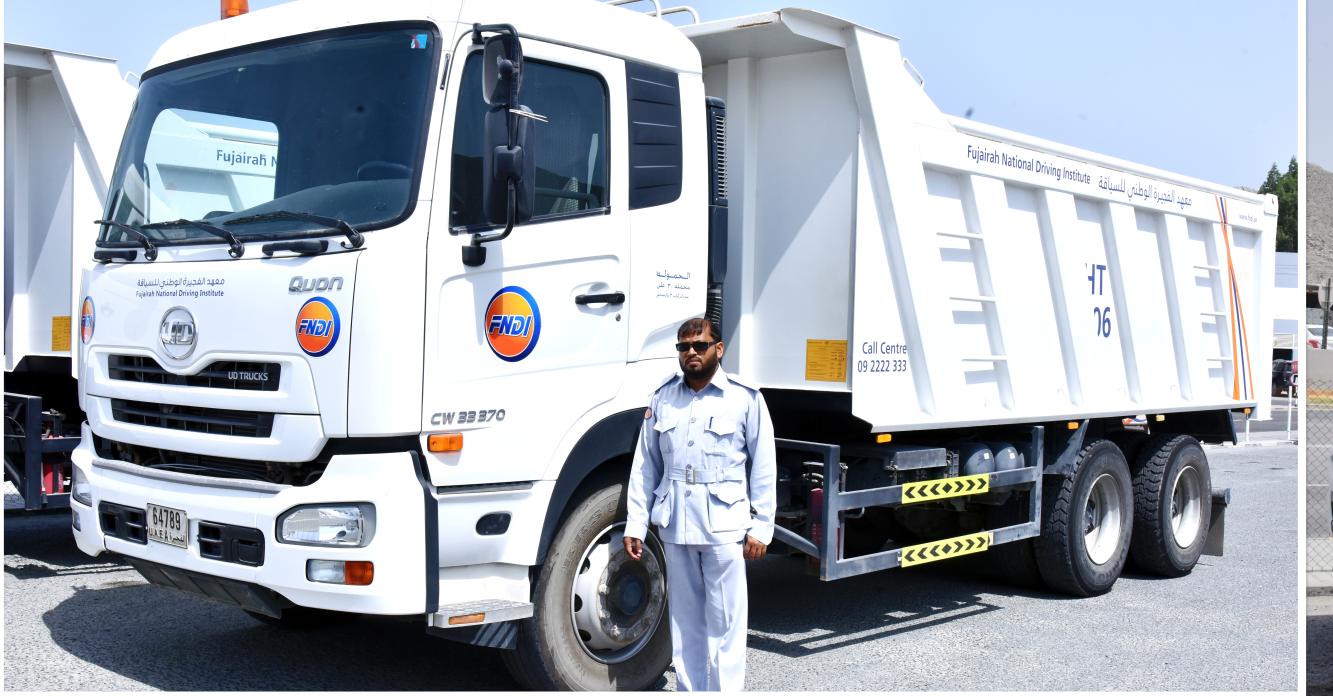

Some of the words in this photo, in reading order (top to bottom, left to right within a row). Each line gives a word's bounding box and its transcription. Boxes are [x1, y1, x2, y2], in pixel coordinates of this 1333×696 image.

[216, 149, 267, 166] Fujairah
[968, 145, 1000, 164] Fujairah
[1002, 152, 1034, 171] National
[1036, 160, 1060, 180] Driving
[1062, 167, 1090, 184] Institute
[288, 275, 344, 294] Quon
[178, 290, 198, 298] Driving
[297, 318, 333, 337] FNDI
[488, 314, 533, 337] FNDI
[862, 341, 878, 354] Call
[880, 342, 908, 354] Centre
[858, 360, 868, 372] 09
[870, 360, 890, 372] 2222
[892, 360, 906, 372] 333
[228, 371, 238, 380] UD
[240, 372, 268, 381] TRUCKS
[430, 412, 456, 425] CW
[153, 506, 180, 531] 64789
